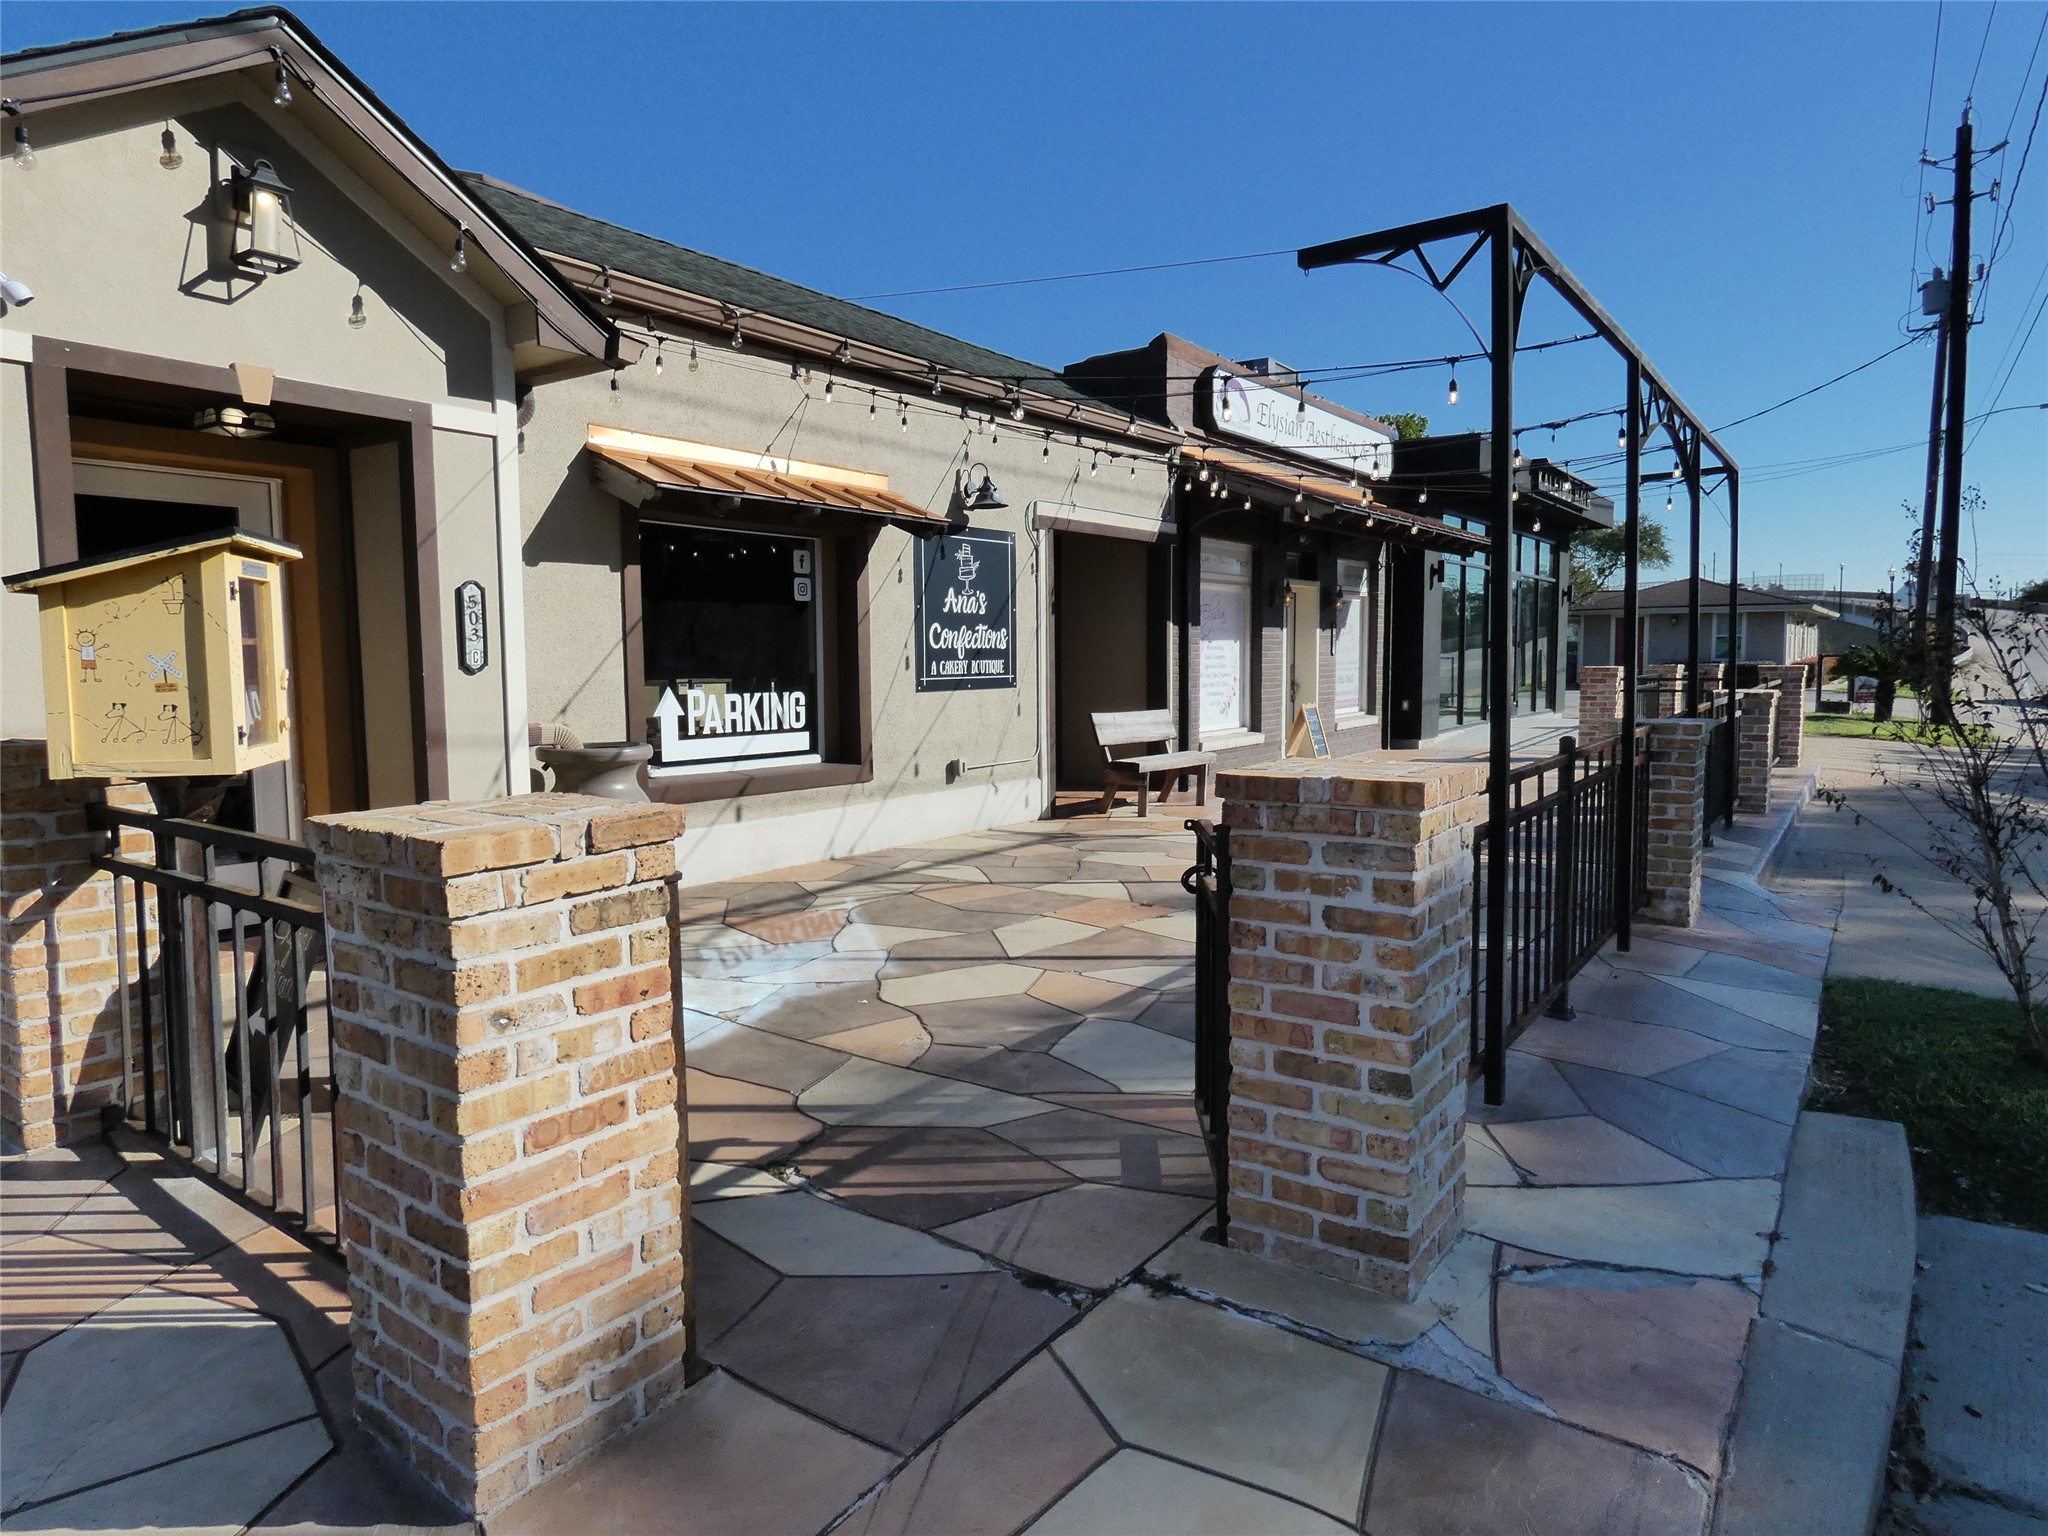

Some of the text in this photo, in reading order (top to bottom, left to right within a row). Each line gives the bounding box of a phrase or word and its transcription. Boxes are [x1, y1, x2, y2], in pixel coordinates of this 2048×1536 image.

[1256, 400, 1303, 443] Elysian
[1306, 420, 1357, 458] Aesthetics
[943, 587, 988, 615] Ana's
[929, 622, 1009, 660] Confections
[931, 659, 1005, 676] A CAKERY BOUTIQUE
[687, 689, 806, 736] PARKING
